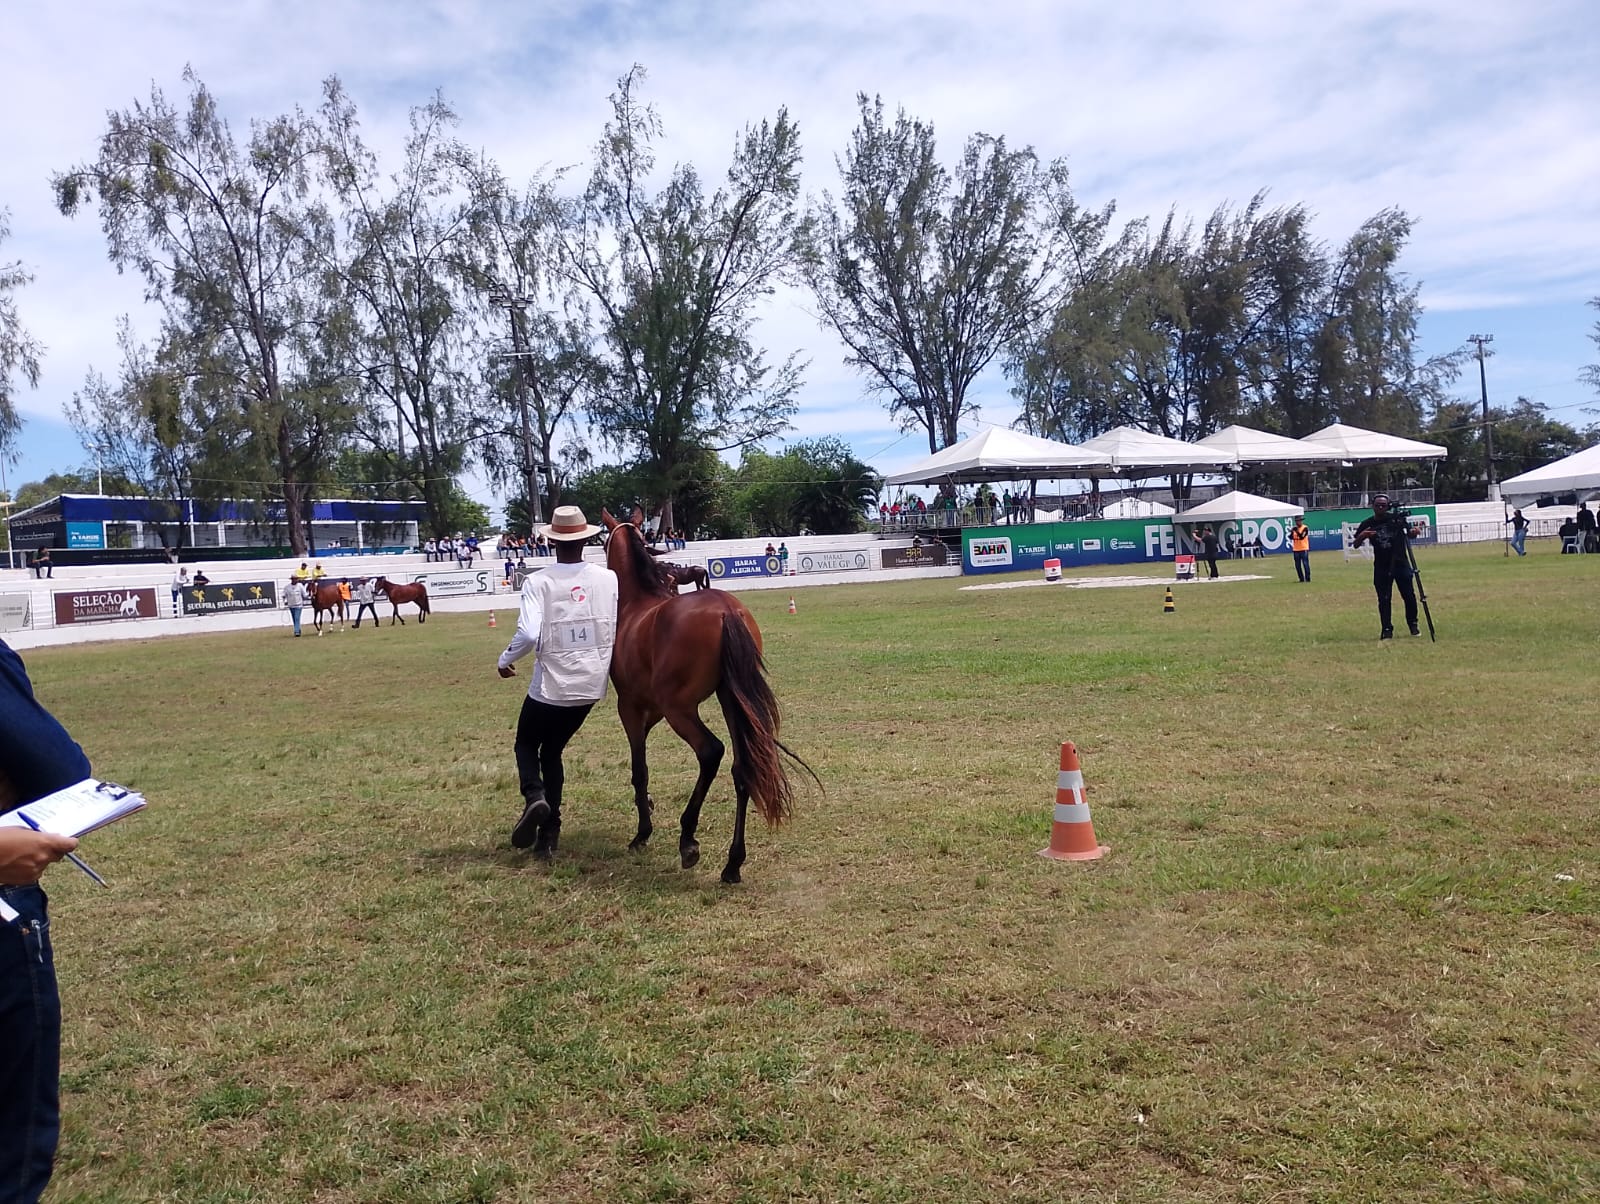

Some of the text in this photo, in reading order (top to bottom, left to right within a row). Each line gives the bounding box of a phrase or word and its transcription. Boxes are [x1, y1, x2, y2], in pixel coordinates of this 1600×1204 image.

[974, 544, 1007, 555] BAHIA
[73, 592, 122, 608] SELEÇÃO
[187, 598, 273, 611] SUCUPIRA SUCUPIRA SUCUPIRA
[74, 605, 121, 616] DA MARCHA
[570, 627, 587, 642] 14
